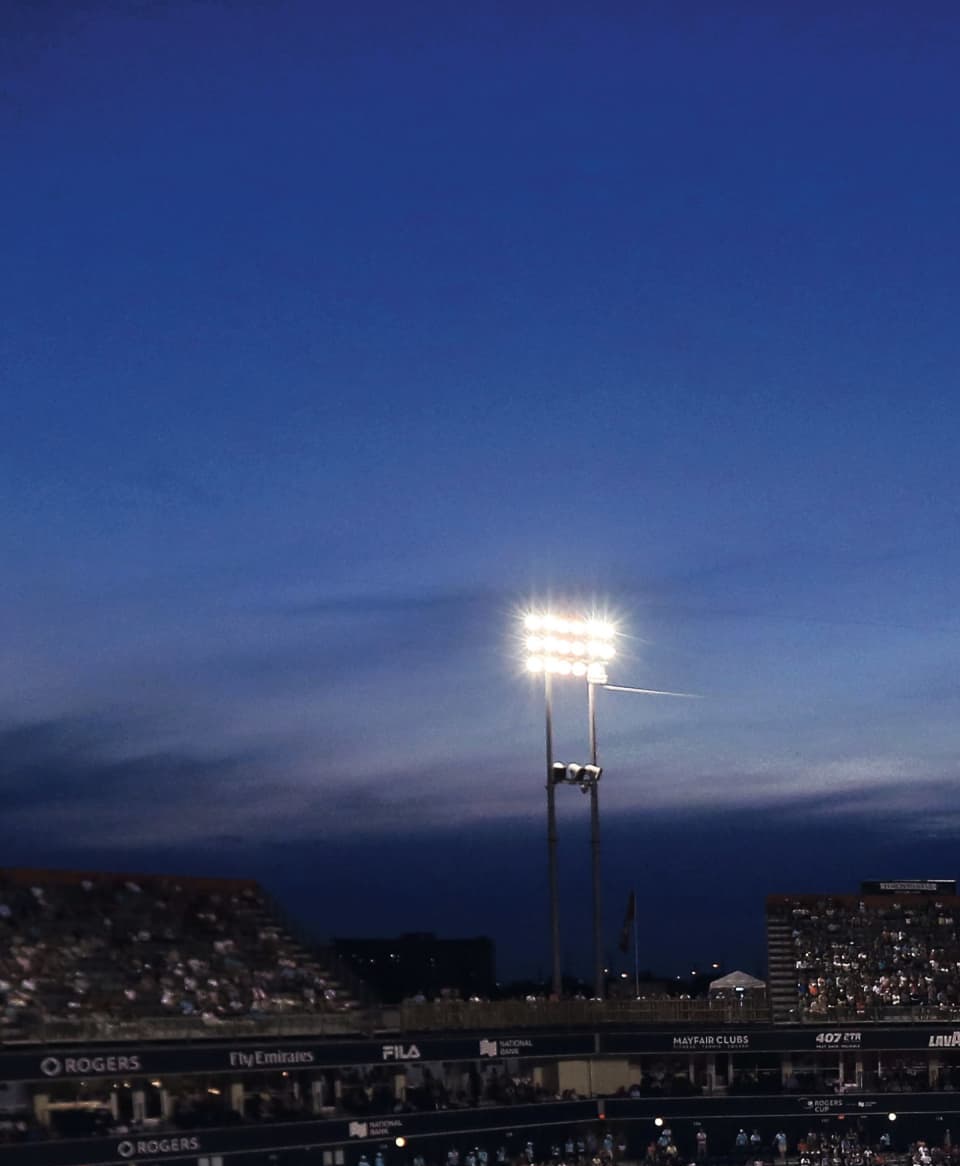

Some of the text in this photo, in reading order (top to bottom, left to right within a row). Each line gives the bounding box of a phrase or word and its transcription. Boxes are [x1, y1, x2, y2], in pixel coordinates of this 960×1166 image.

[673, 1034, 750, 1045] MAYFAIR CLUBS
[816, 1033, 842, 1043] 407
[229, 1050, 314, 1067] Fly Emirates
[382, 1044, 421, 1060] FILA
[65, 1055, 142, 1073] ROGERS
[814, 1099, 843, 1107] ROGERS
[137, 1137, 200, 1155] ROGERS
